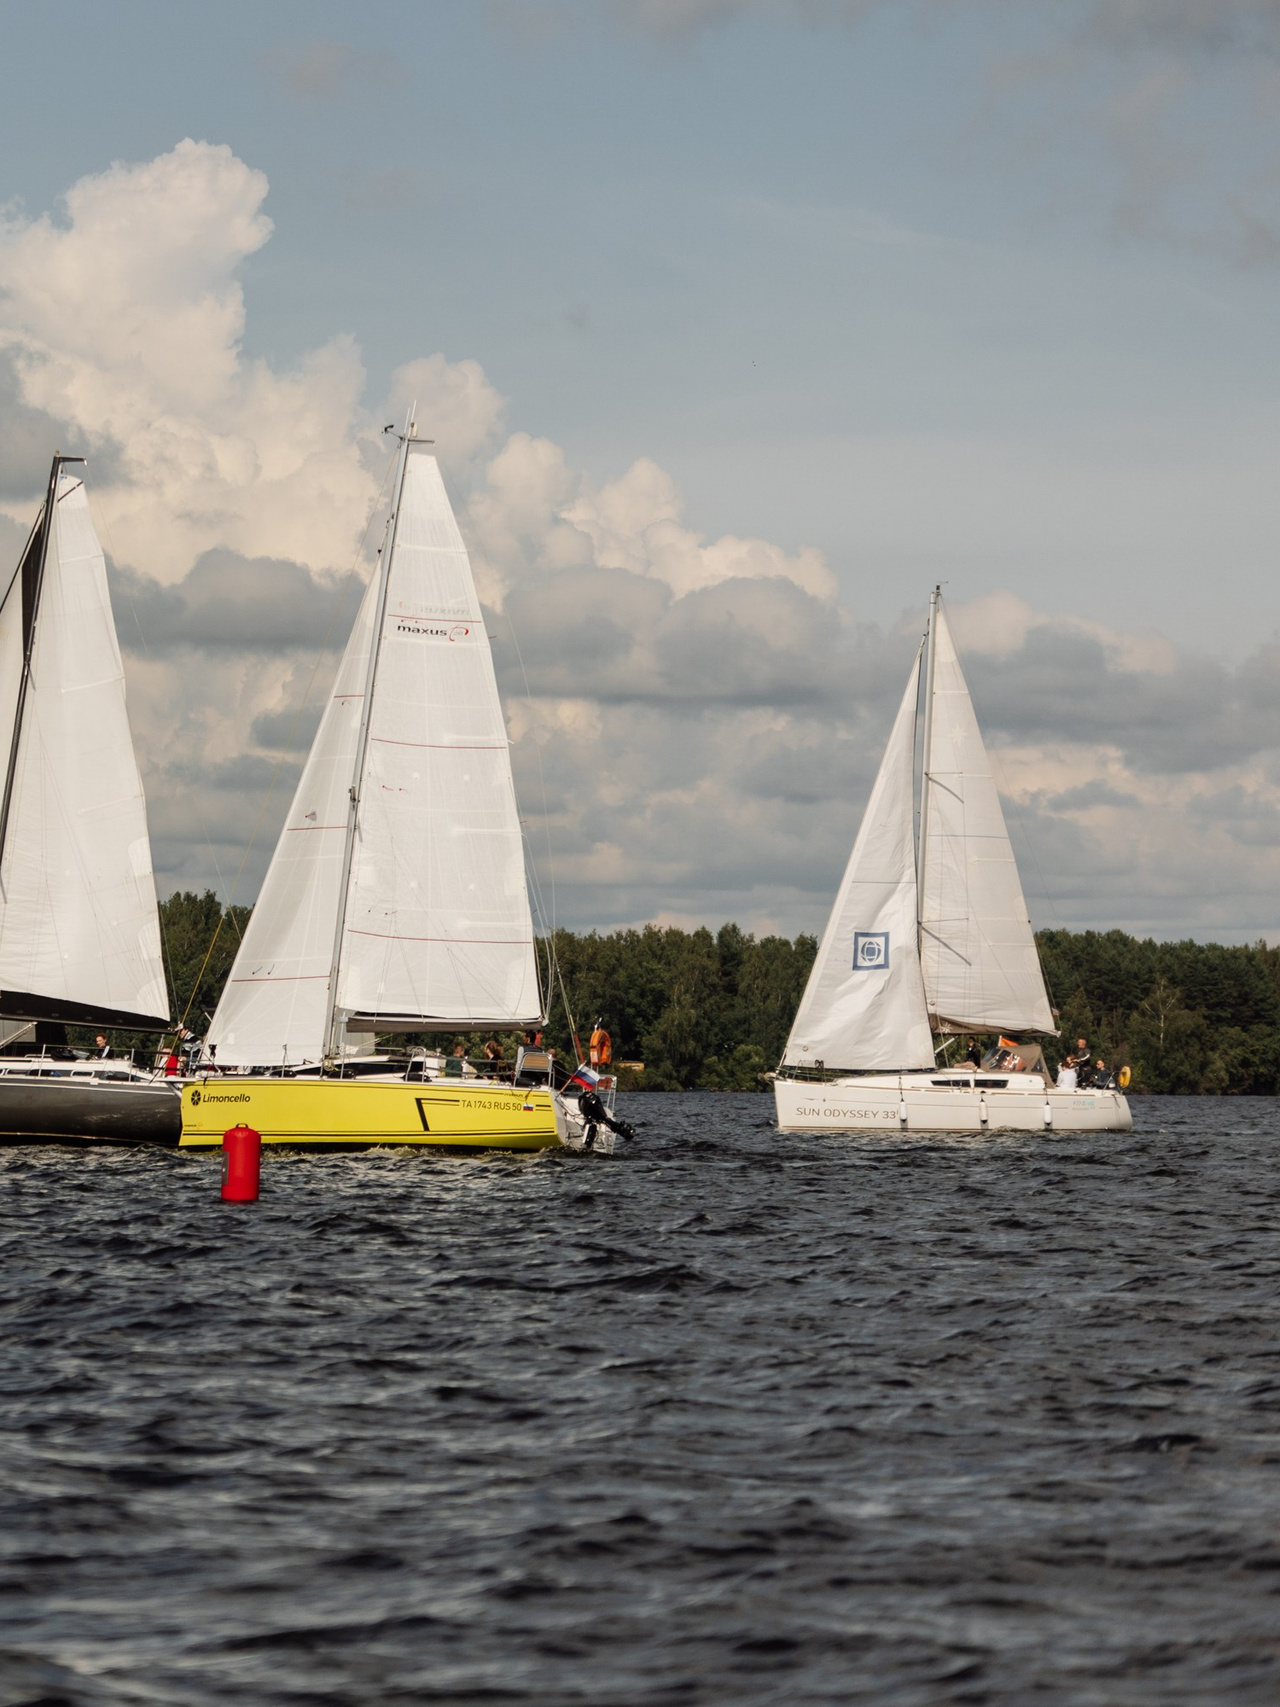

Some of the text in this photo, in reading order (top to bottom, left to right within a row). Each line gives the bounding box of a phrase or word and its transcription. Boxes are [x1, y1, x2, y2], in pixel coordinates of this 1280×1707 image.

[397, 625, 448, 636] maxus
[202, 1093, 251, 1103] Limoncello
[493, 1101, 511, 1111] RUS
[512, 1103, 522, 1112] 50
[796, 1107, 820, 1117] SUN
[823, 1108, 879, 1119] ODYSSEY
